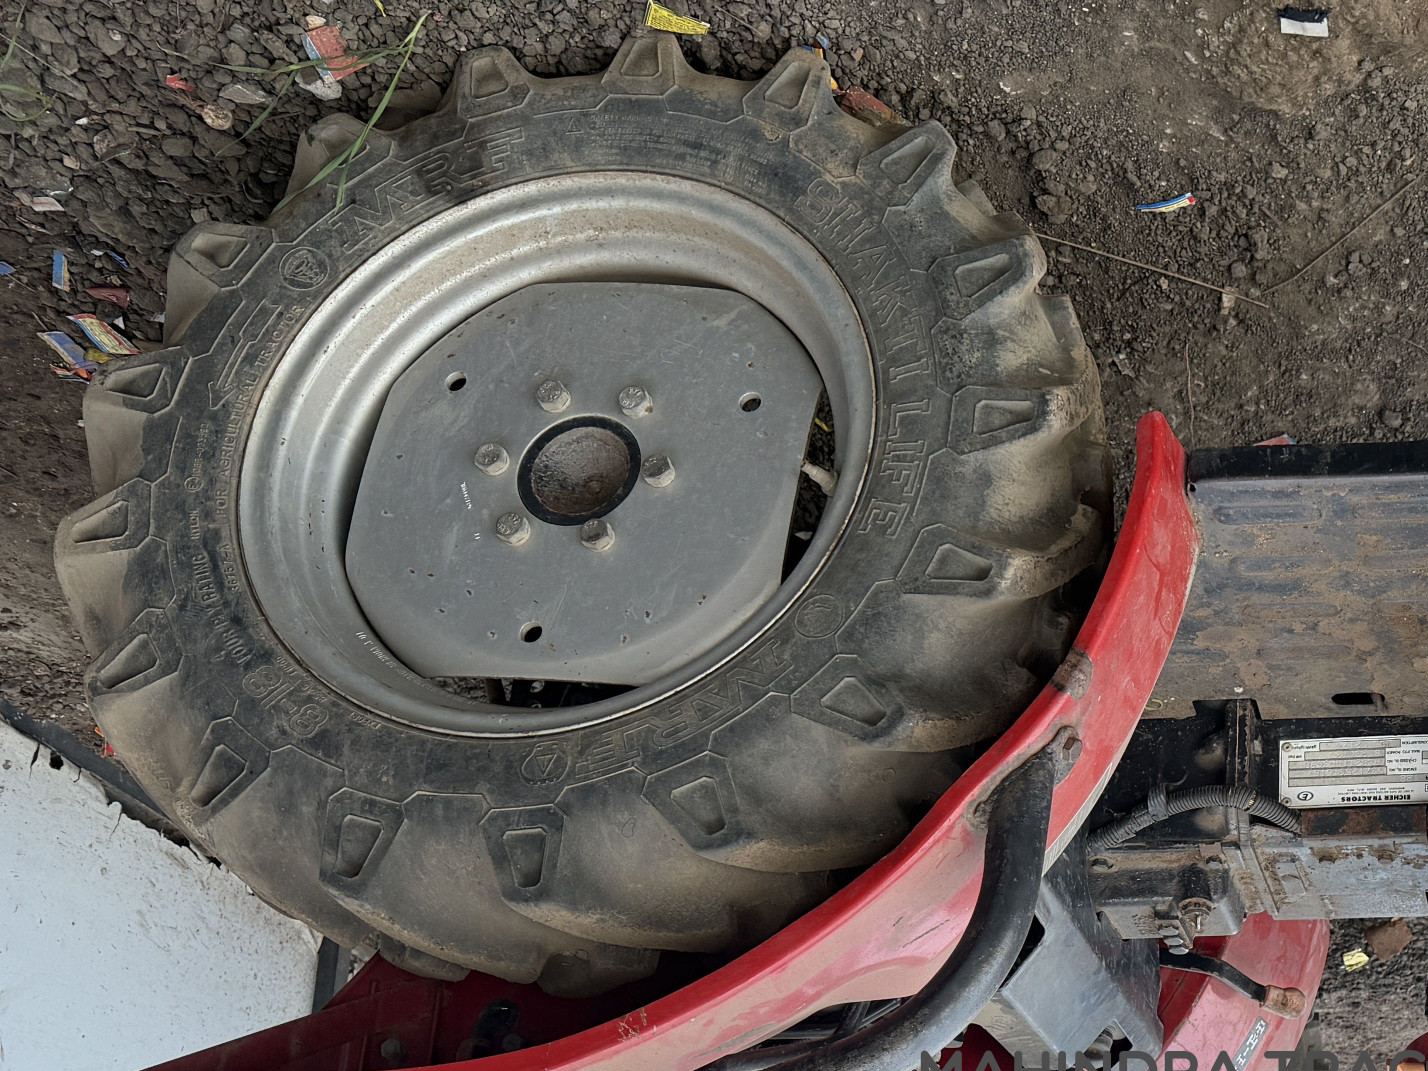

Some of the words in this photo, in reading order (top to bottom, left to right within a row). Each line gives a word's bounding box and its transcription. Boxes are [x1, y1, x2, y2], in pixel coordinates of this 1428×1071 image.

[329, 127, 524, 253] MRF
[794, 178, 931, 384] SHAKTI
[257, 304, 305, 369] TRACTOR
[217, 370, 257, 479] AGRICULTURAL
[858, 398, 931, 539] LIFE
[215, 489, 228, 518] FOR
[241, 665, 328, 738] 8-18
[575, 639, 780, 779] MRF
[1340, 795, 1383, 803] TRACTORS
